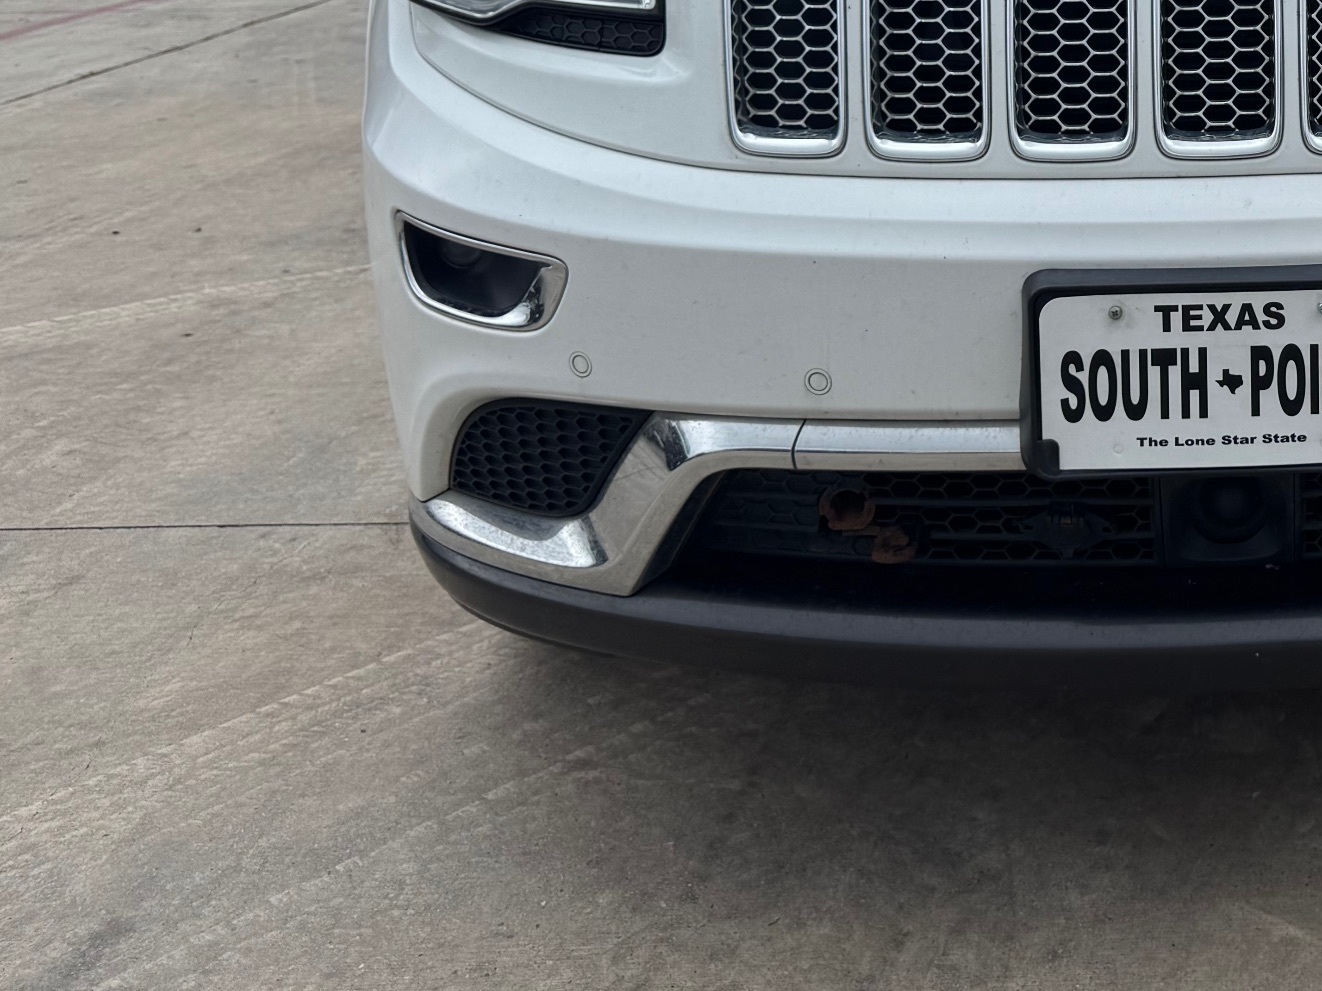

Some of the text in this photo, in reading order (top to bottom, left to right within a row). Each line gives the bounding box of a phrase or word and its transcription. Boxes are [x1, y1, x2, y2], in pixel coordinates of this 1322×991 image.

[1154, 301, 1286, 332] TEXAS
[1060, 346, 1208, 423] SOUTH
[1136, 432, 1307, 447] The Lone Star State
